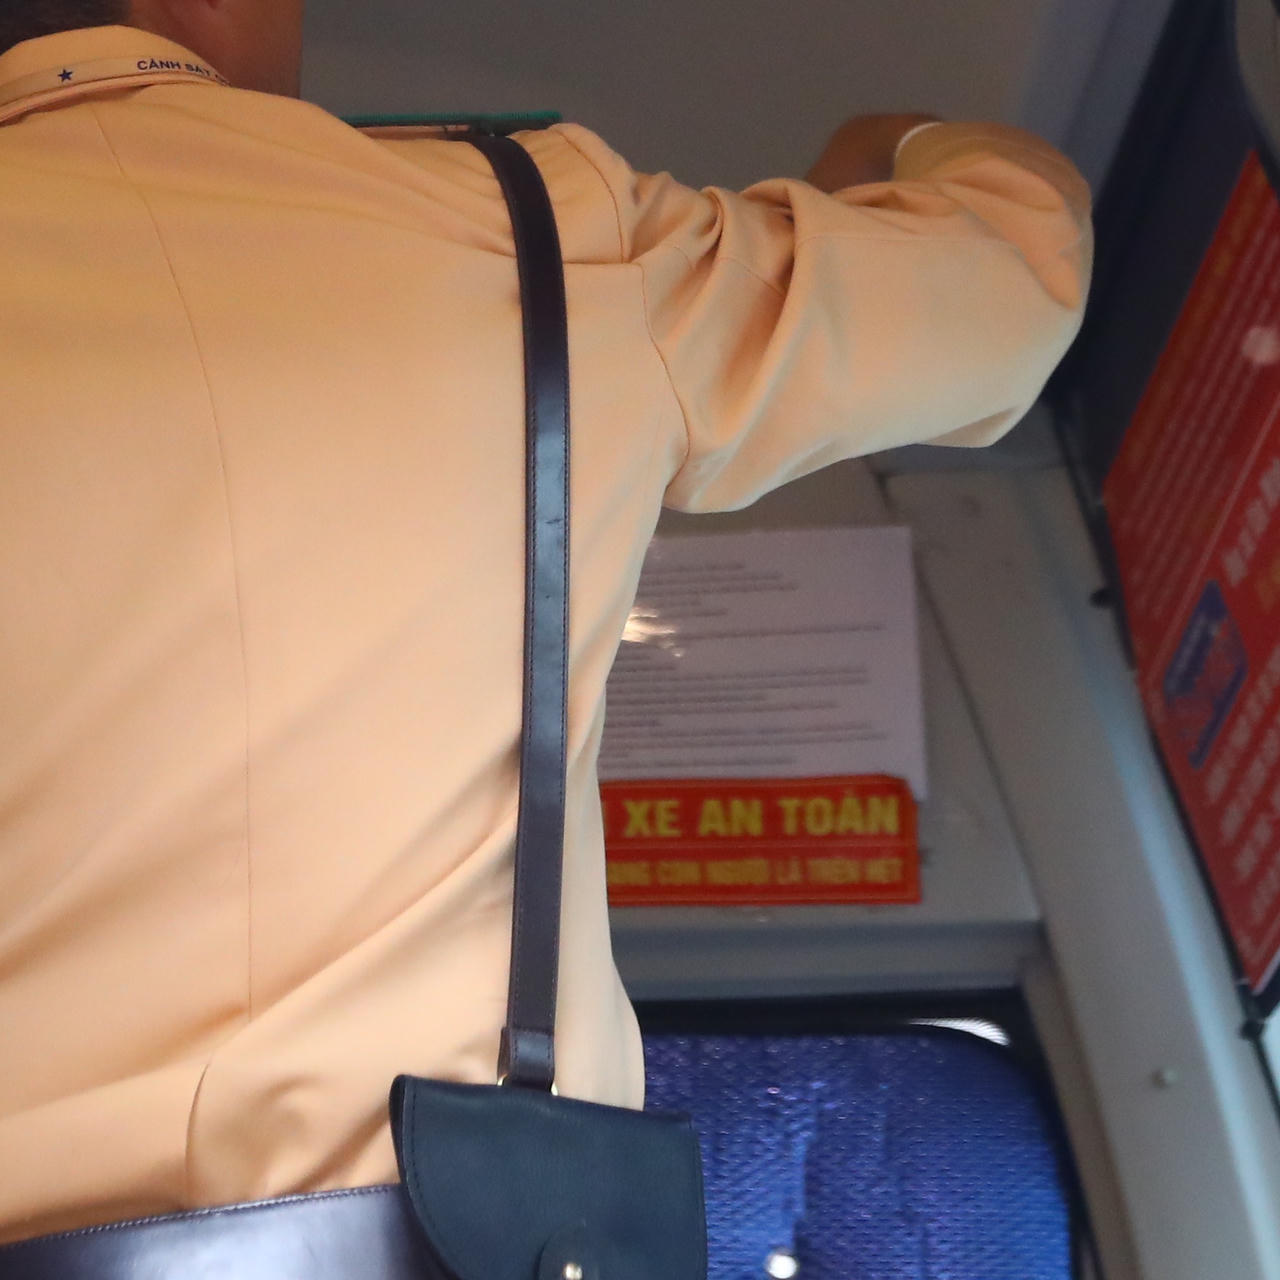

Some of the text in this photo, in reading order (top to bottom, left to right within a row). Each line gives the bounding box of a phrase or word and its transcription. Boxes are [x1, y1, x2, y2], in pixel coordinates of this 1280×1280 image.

[623, 787, 900, 838] XE AN TOÀN
